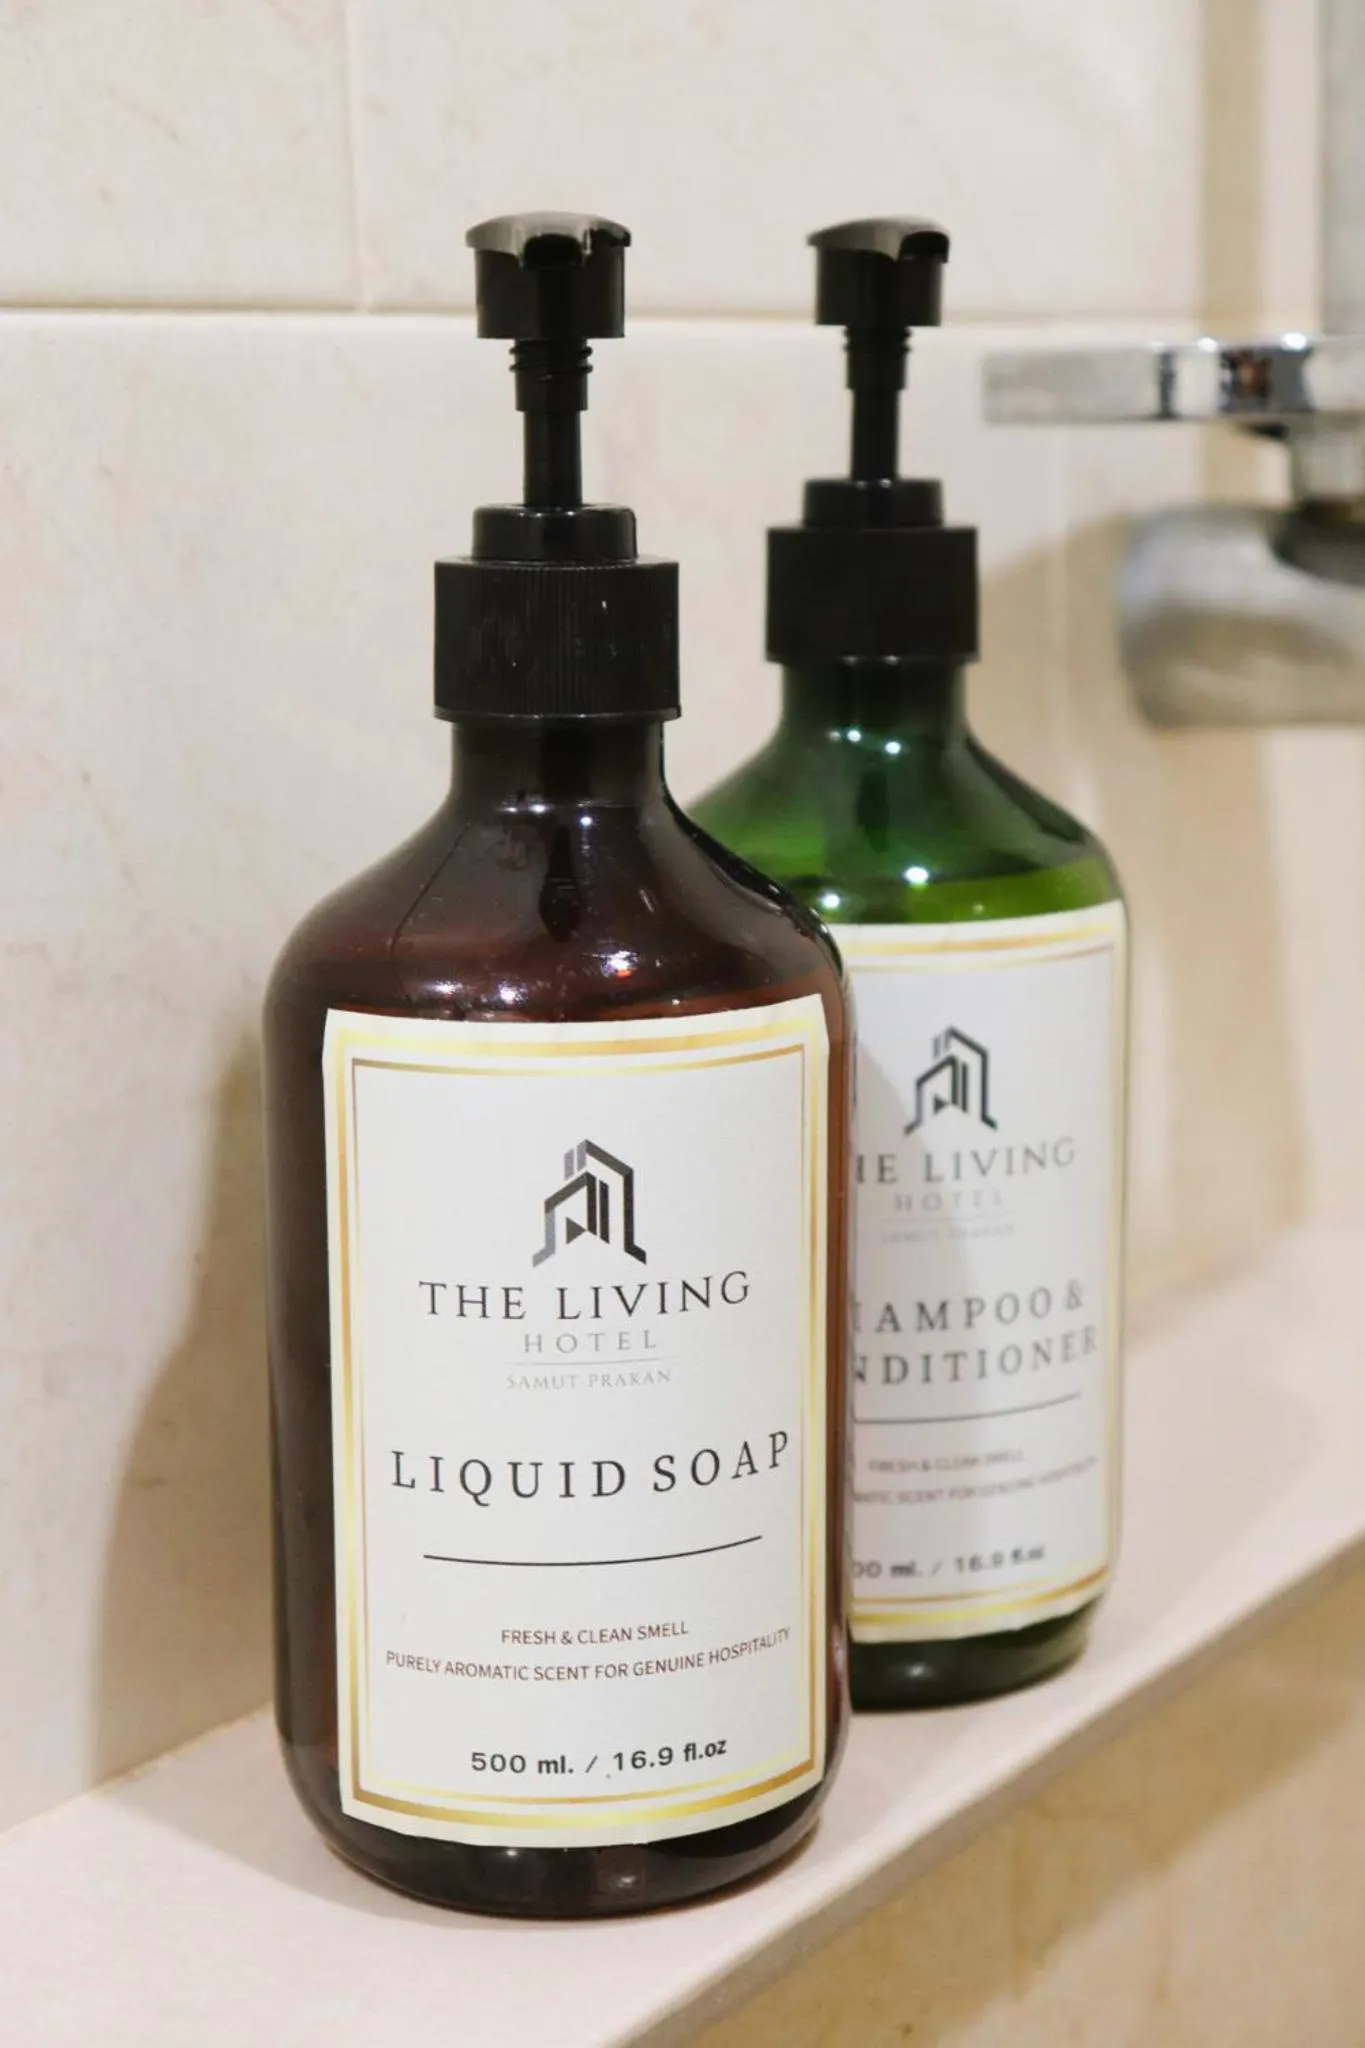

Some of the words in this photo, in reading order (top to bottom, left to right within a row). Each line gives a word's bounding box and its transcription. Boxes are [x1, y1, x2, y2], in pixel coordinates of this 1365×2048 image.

[925, 1138, 1075, 1184] LIVING
[894, 1189, 1004, 1212] HOTEL
[419, 1281, 526, 1320] THE
[557, 1270, 751, 1320] LIVING
[853, 1286, 1052, 1334] AMPOO
[1065, 1279, 1083, 1310] &
[524, 1329, 657, 1354] HOTEL
[507, 1373, 579, 1390] SAMUT
[589, 1370, 672, 1389] PRAKAN
[391, 1450, 626, 1507] LIQUID
[652, 1430, 789, 1493] SOAP
[854, 1562, 882, 1577] 00
[501, 1628, 557, 1646] FRESH
[562, 1629, 573, 1645] &
[577, 1626, 633, 1645] CLEAN
[637, 1621, 689, 1641] SMELL
[386, 1650, 443, 1674] PURELY
[444, 1661, 530, 1681] AROMATIC
[534, 1665, 590, 1681] SCENT
[595, 1663, 629, 1679] FOR
[633, 1652, 705, 1677] GENUINE
[708, 1626, 792, 1665] HOSPITALITY
[470, 1751, 526, 1774] 500
[537, 1753, 574, 1774] ml.
[585, 1755, 598, 1773] /
[612, 1746, 674, 1772] 16.9
[683, 1738, 728, 1763] fl.oz
